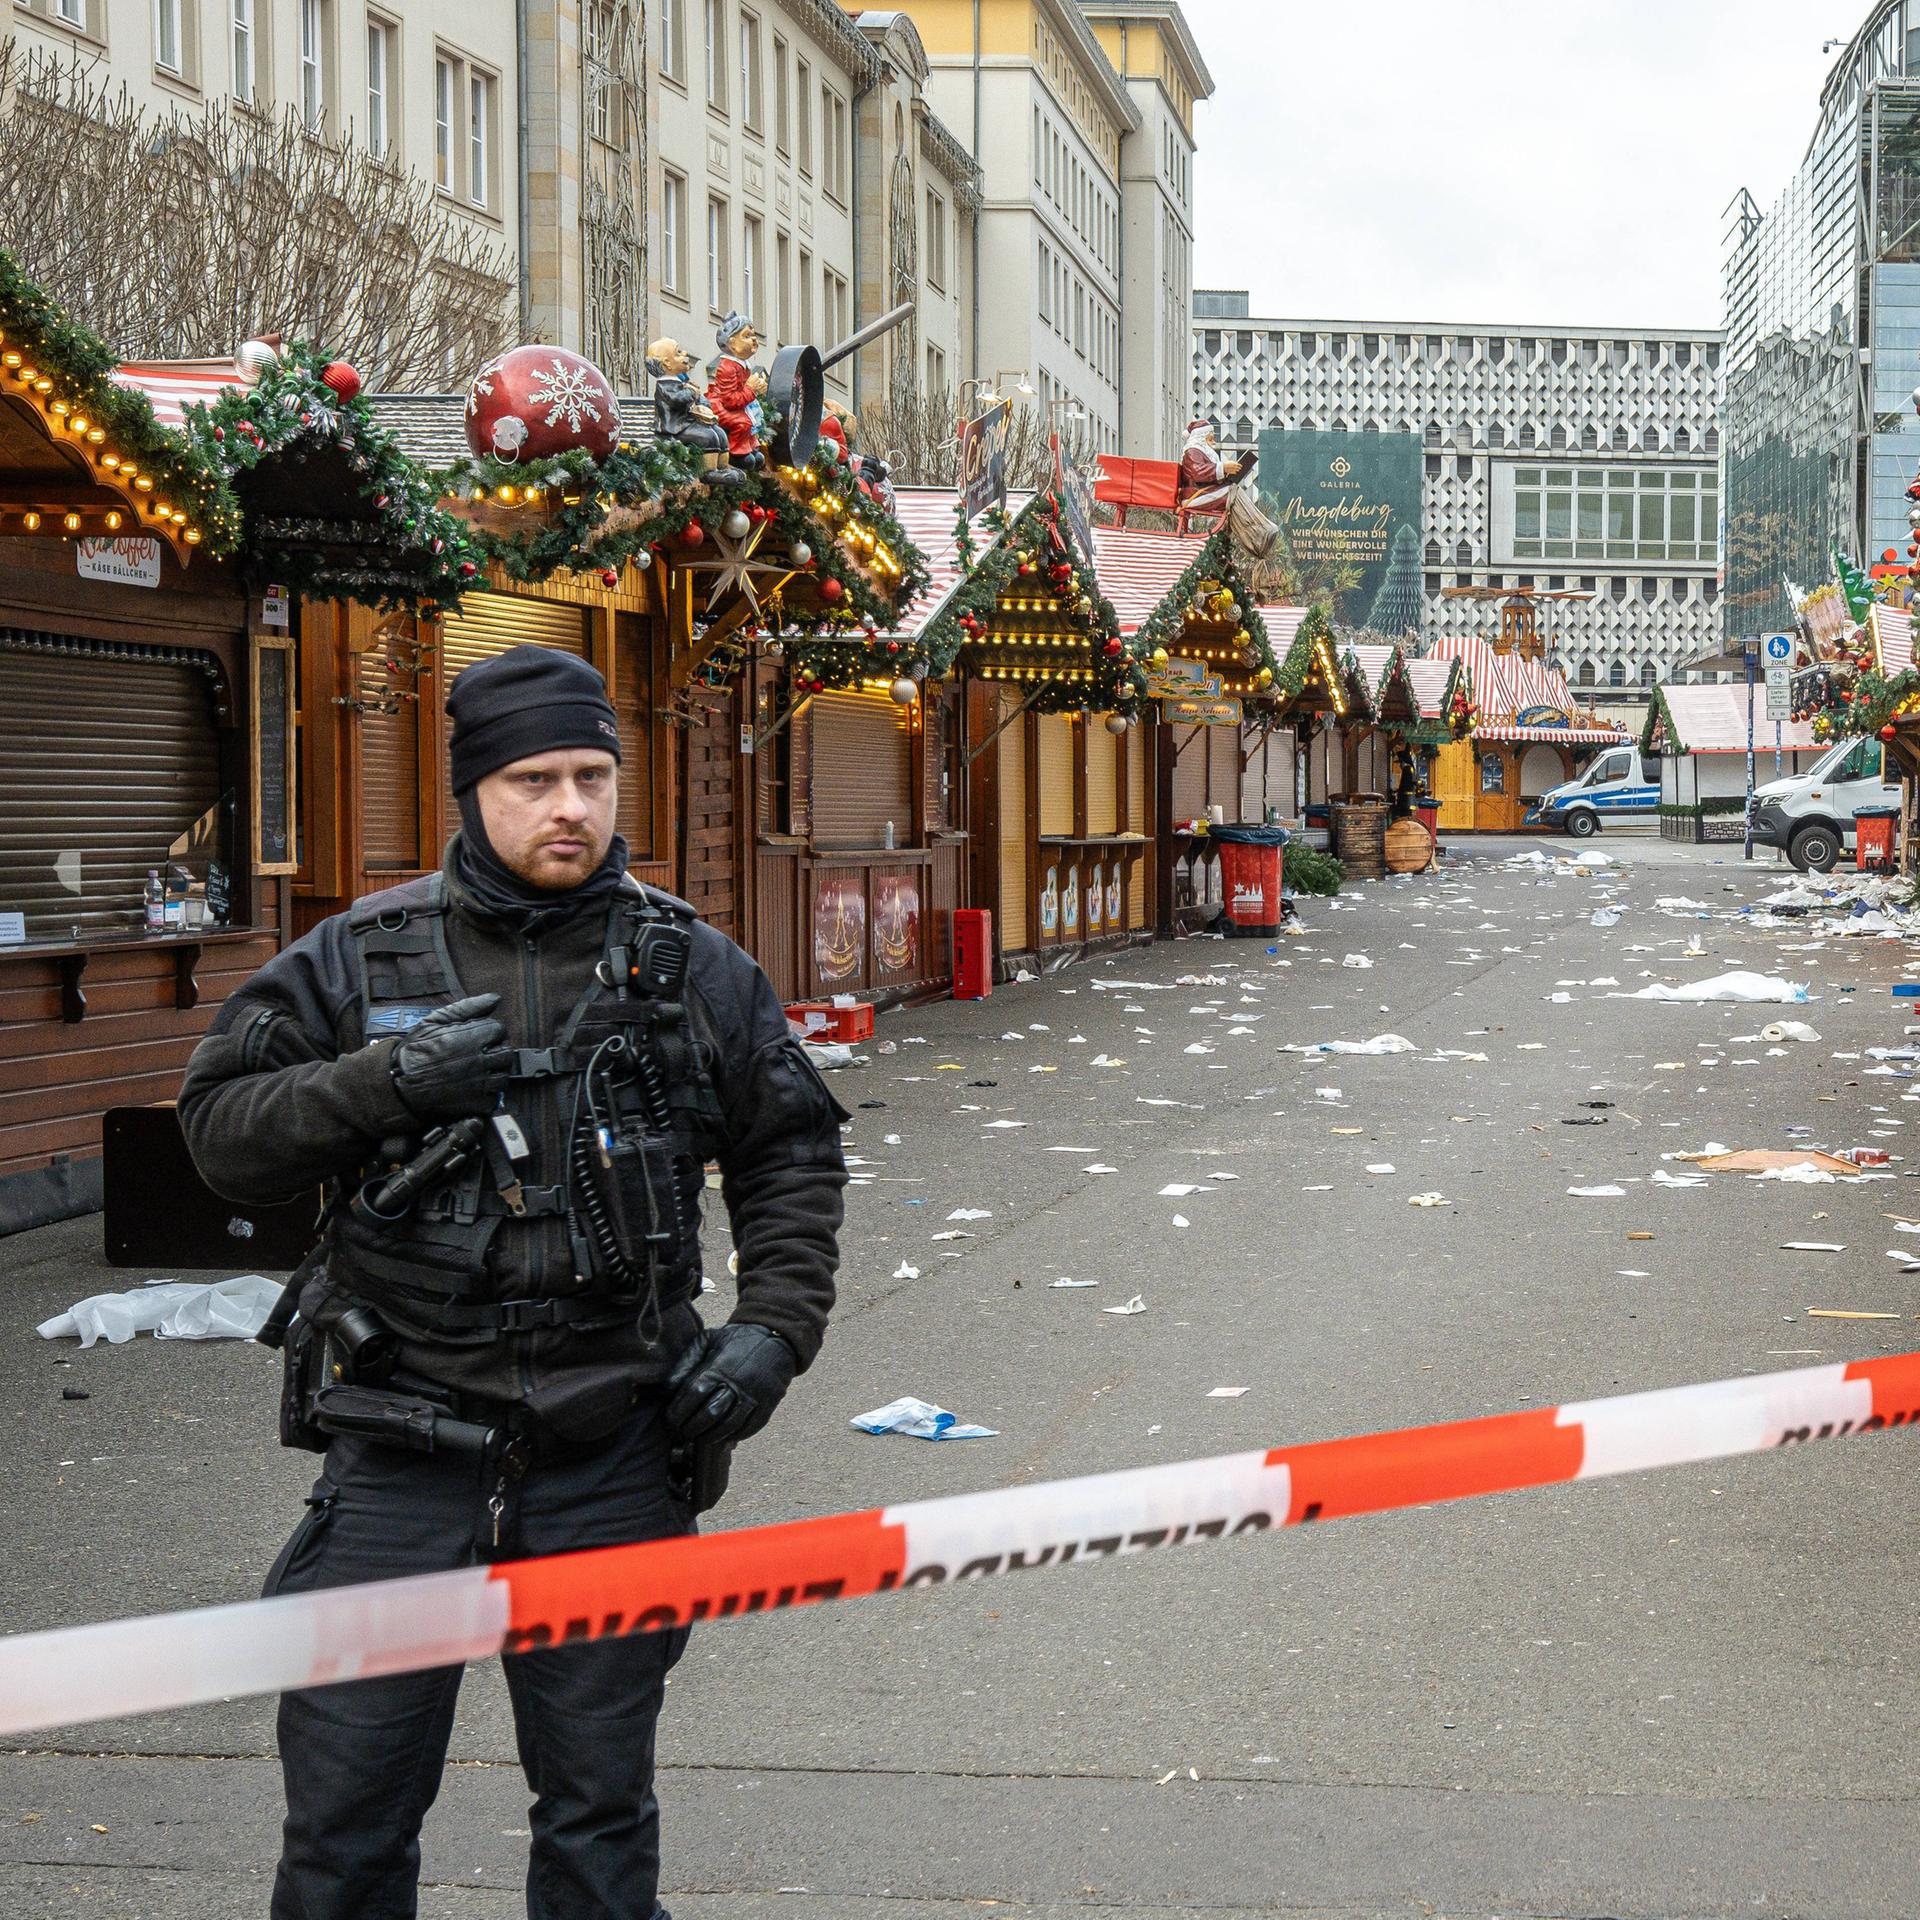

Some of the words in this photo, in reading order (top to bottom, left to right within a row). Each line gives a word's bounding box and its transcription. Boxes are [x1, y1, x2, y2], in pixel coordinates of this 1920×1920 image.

[1283, 494, 1396, 533] Magdeburg,
[1292, 529, 1314, 537] WIR
[1315, 528, 1368, 538] WÜNSCHEN
[1371, 530, 1387, 538] DIR
[1292, 540, 1313, 548] EINE
[1316, 541, 1387, 549] WUNDERVOLLE
[1297, 551, 1382, 561] WEIHNACHTSZEIT!
[92, 560, 111, 575] KÄSE
